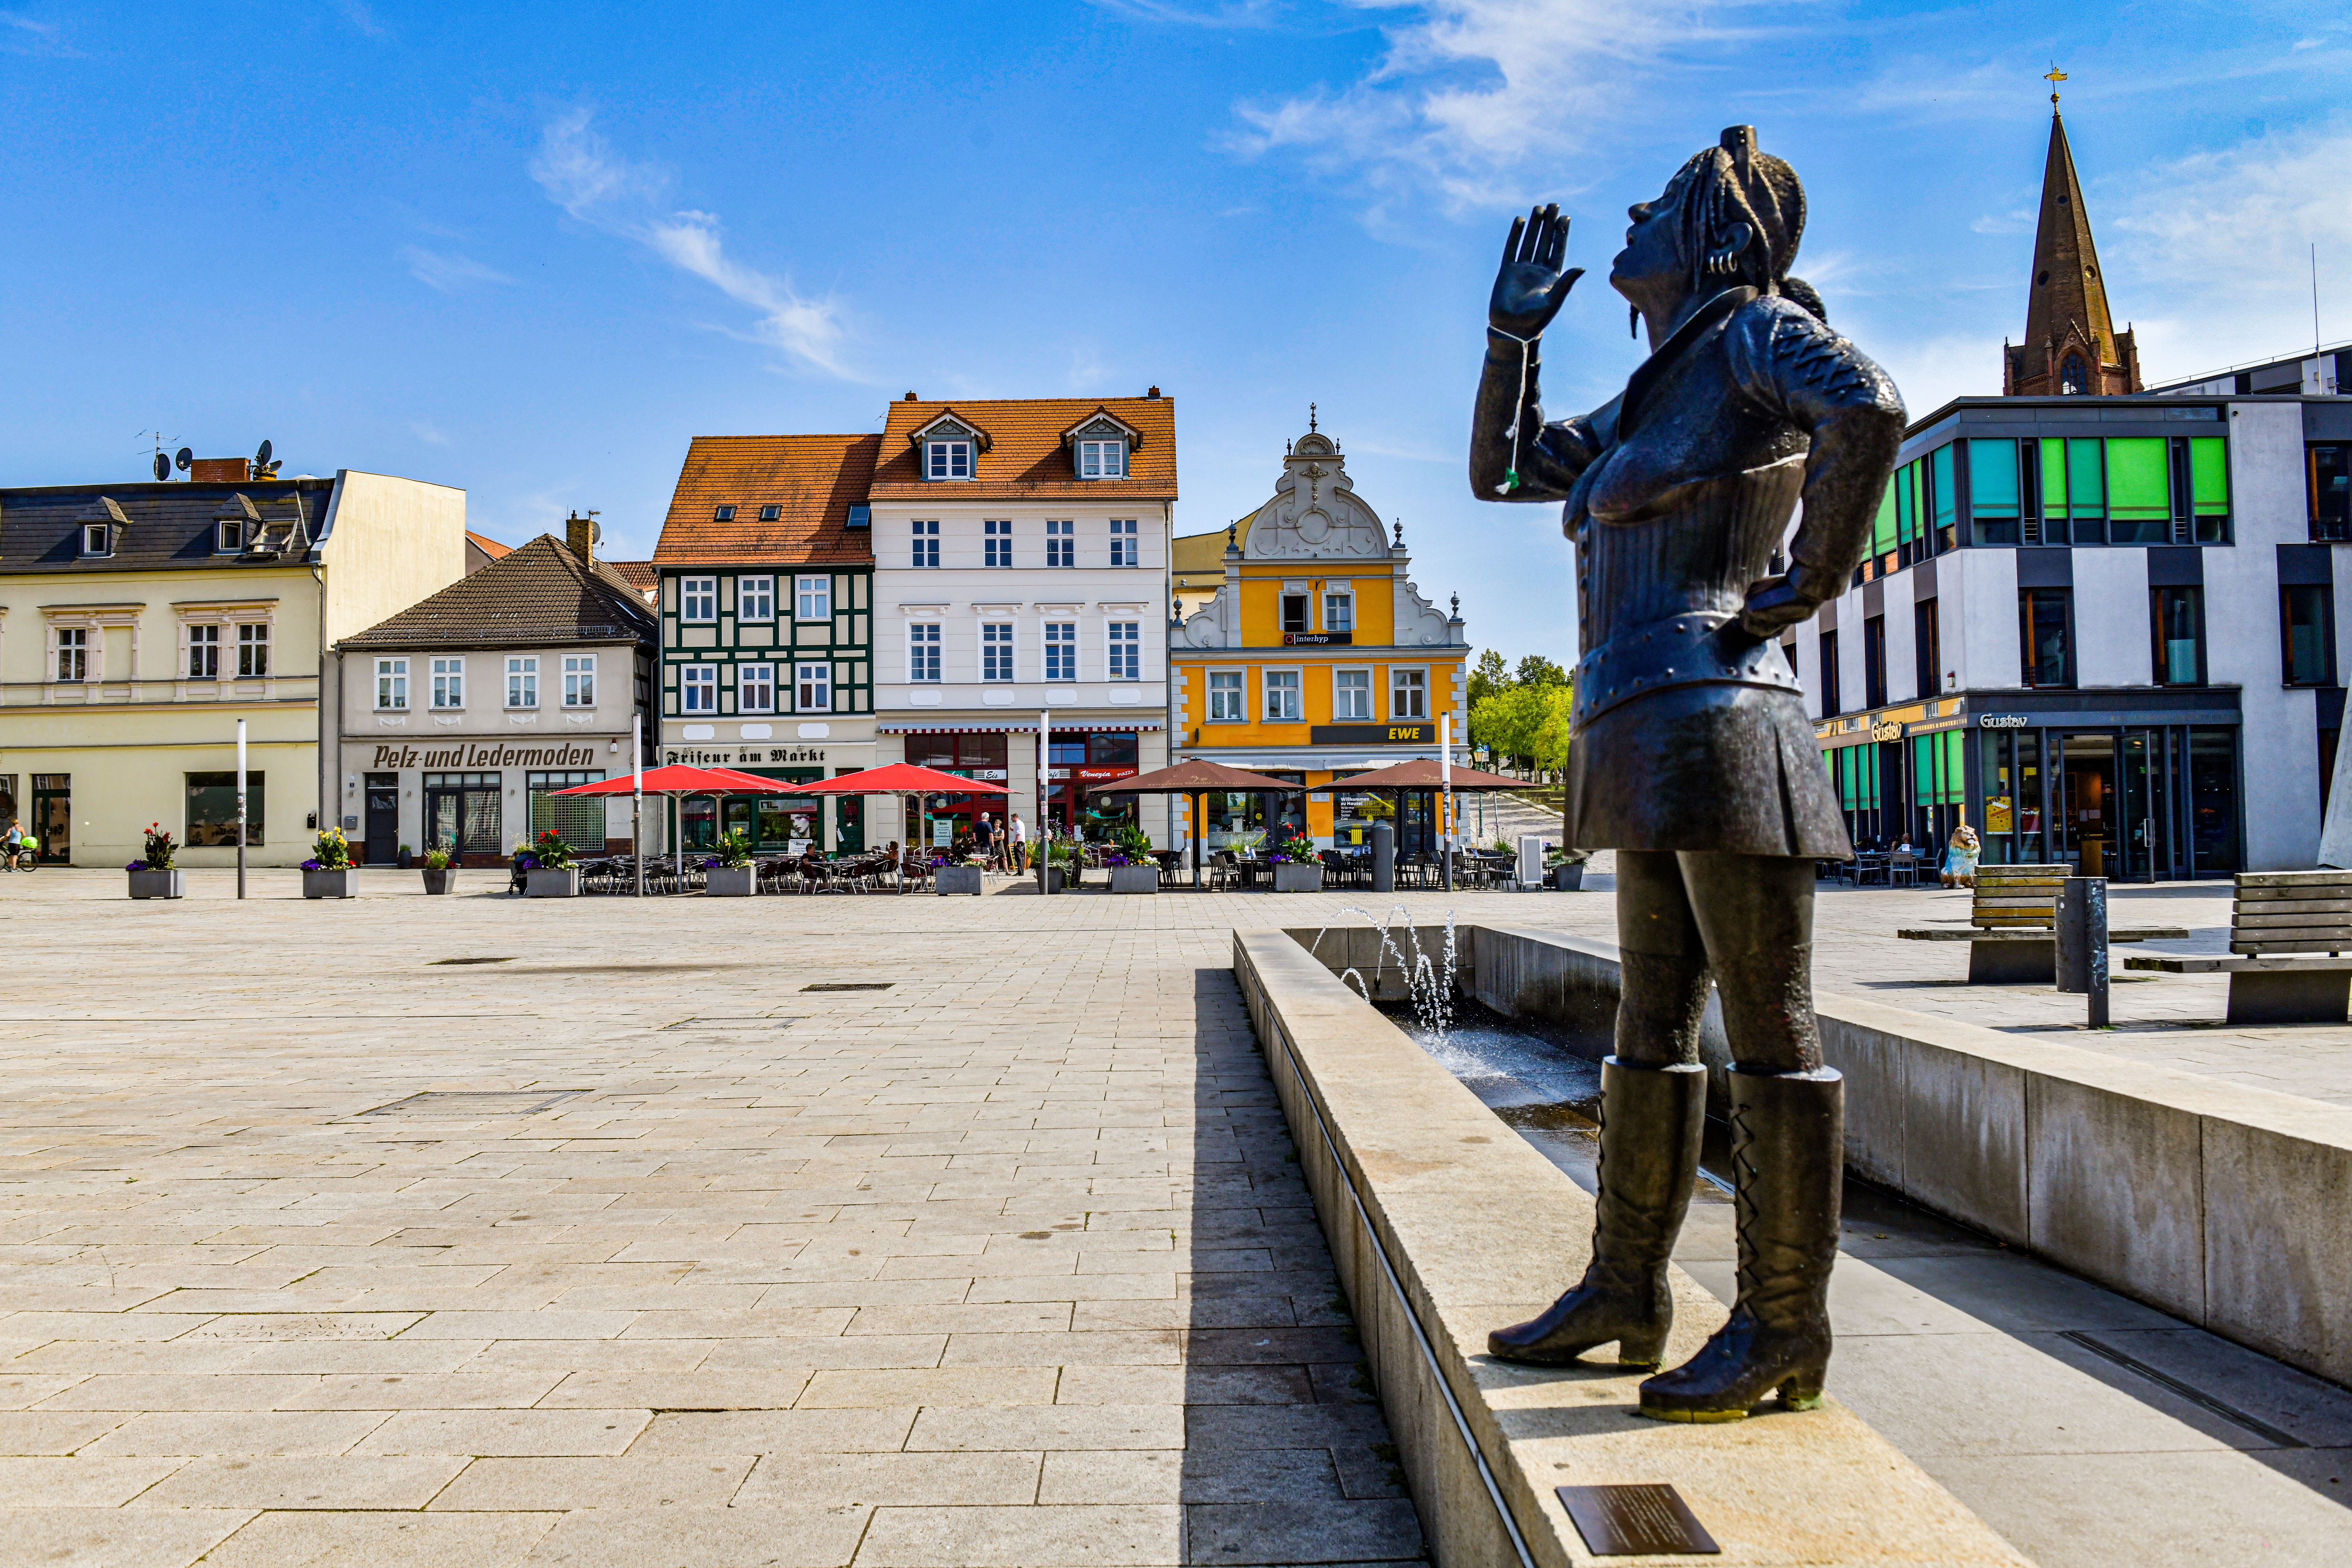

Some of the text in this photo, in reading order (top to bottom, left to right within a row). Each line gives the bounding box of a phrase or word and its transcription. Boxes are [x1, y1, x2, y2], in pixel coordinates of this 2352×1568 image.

[1909, 723, 1935, 733] KAFFEEHAUS
[1940, 718, 1967, 728] BROTKULTUR
[1980, 713, 2027, 728] Gustav
[1388, 728, 1420, 739] EWE
[1871, 721, 1902, 742] Gustav
[424, 744, 465, 767] und
[466, 743, 594, 767] Ledermoden
[739, 752, 762, 762] am
[770, 749, 825, 762] Markt
[1048, 771, 1059, 779] afé
[1080, 770, 1111, 779] Venezia
